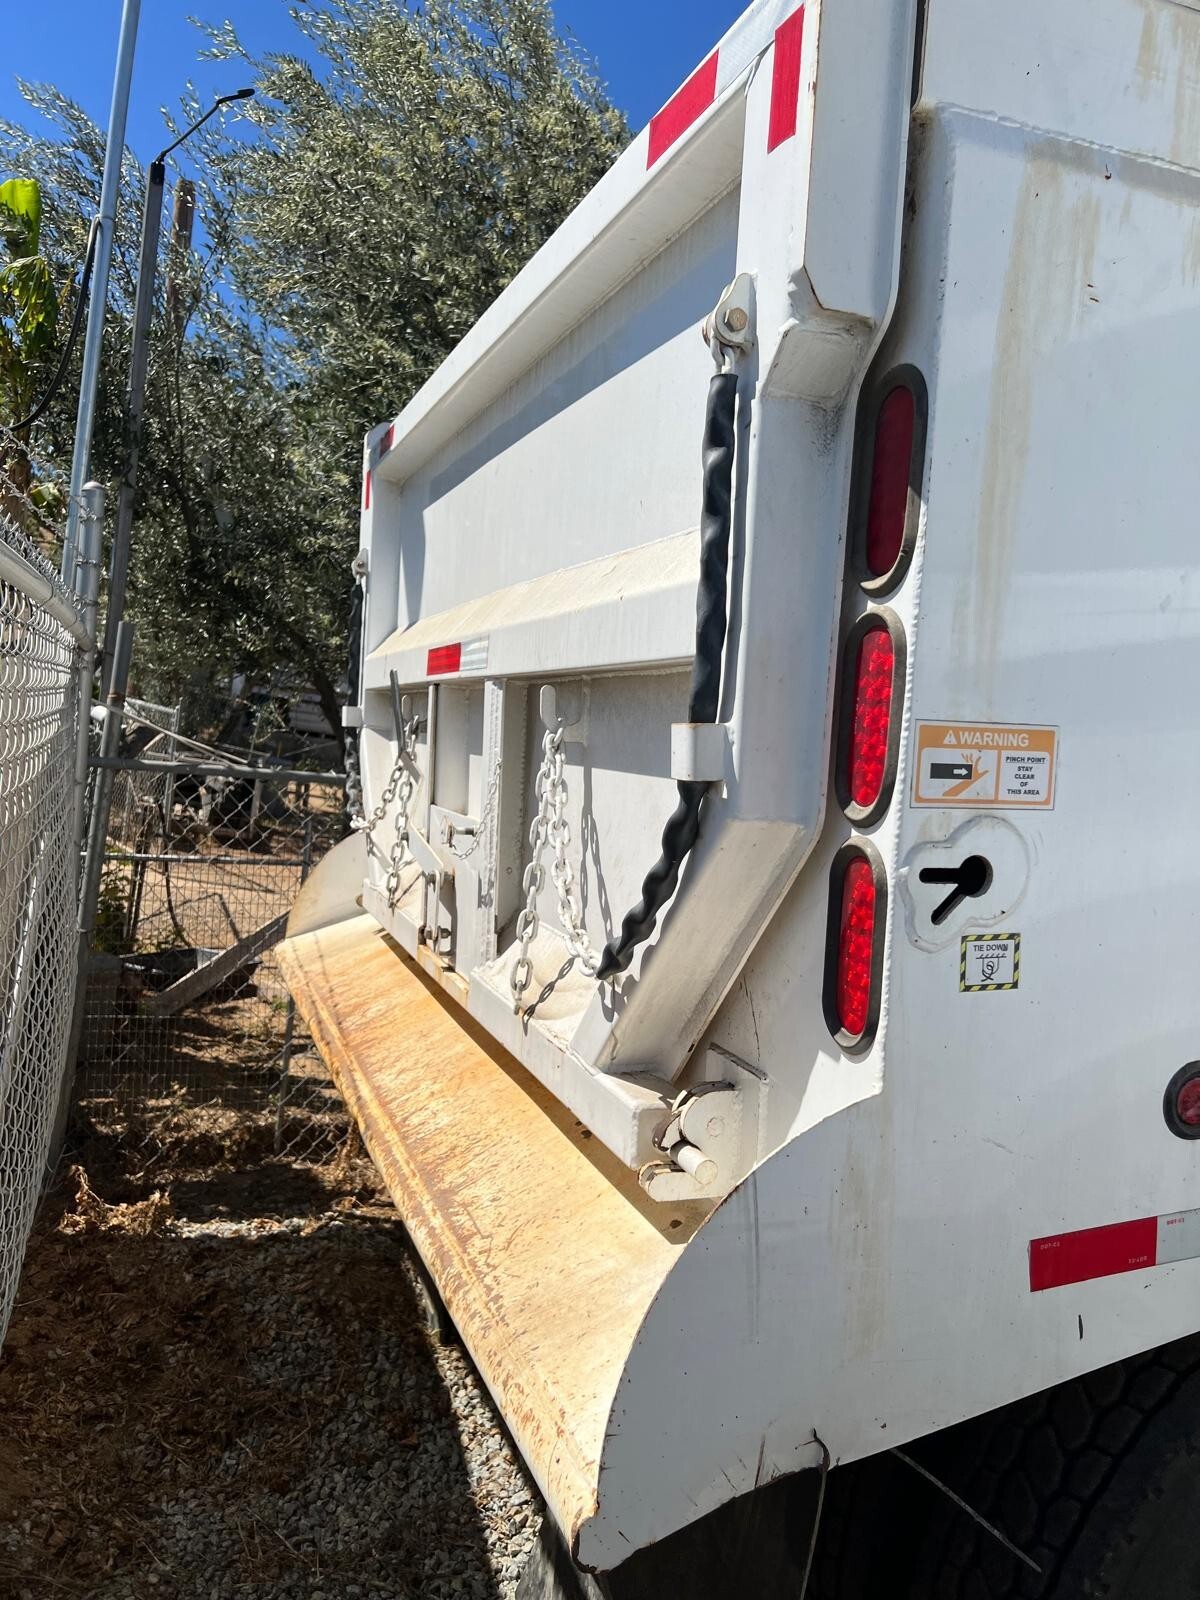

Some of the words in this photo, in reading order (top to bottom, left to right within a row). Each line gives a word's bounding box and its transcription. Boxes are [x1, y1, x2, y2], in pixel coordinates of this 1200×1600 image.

[959, 731, 1029, 747] WARNING
[973, 944, 985, 952] TIE
[986, 943, 1009, 952] DOWN
